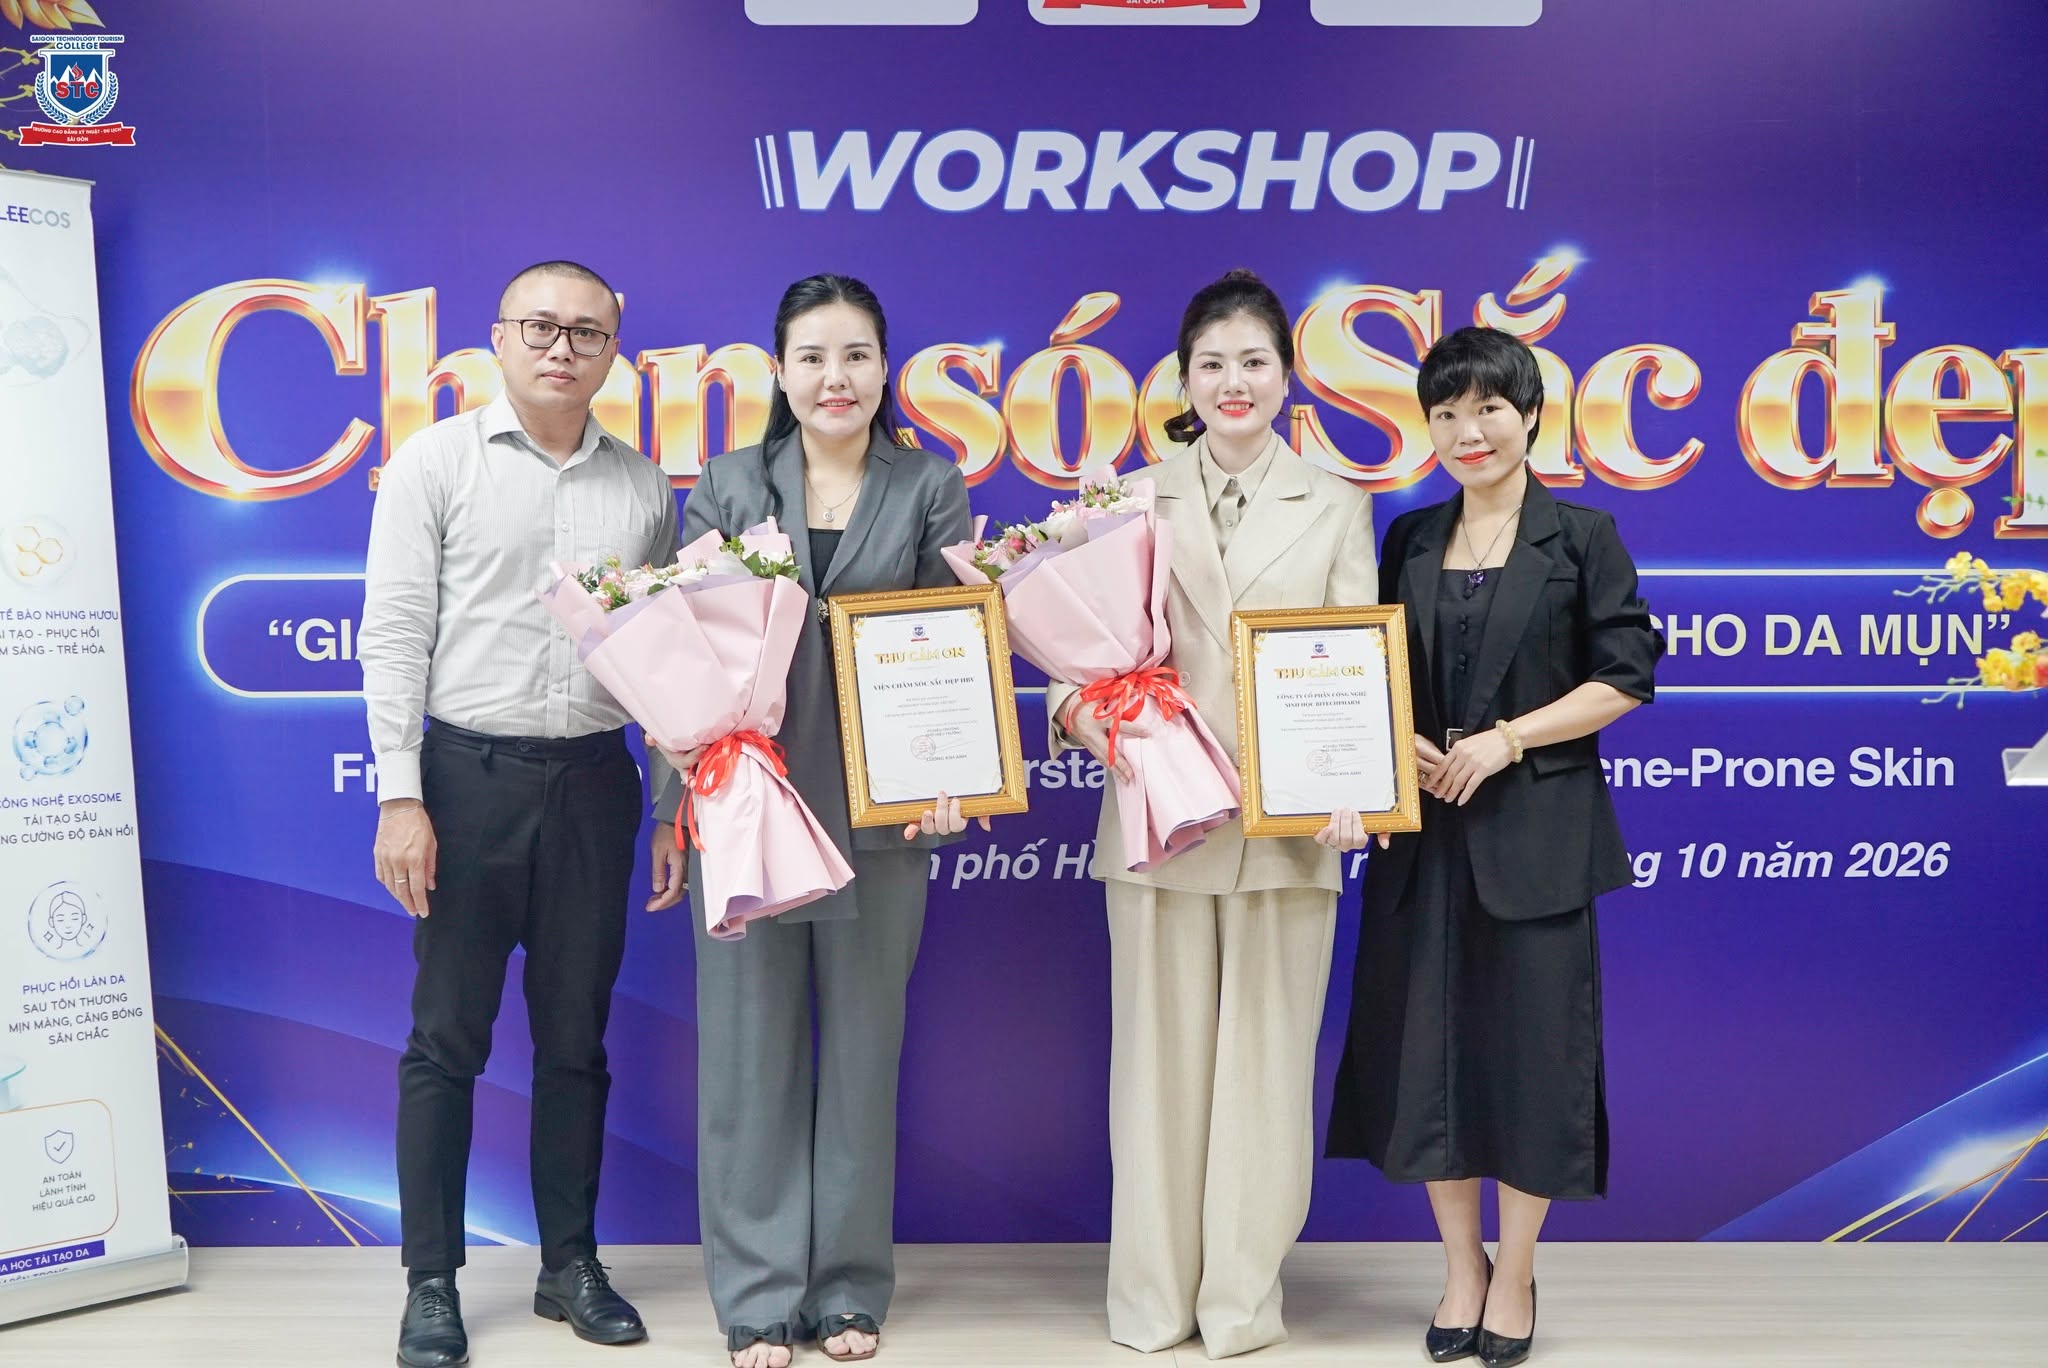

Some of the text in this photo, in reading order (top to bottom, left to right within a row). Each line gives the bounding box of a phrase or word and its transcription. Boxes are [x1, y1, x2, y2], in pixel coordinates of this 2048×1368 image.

[788, 129, 1501, 211] WORKSHOP
[17, 608, 42, 620] BÀO
[45, 610, 86, 620] NHUNG
[89, 610, 118, 620] HƯƠU
[9, 629, 33, 640] TẠO
[46, 628, 78, 640] PHỤC
[1764, 614, 1842, 656] DA
[1860, 614, 2011, 666] MỤN”
[12, 644, 45, 655] SÁNG
[1848, 747, 1955, 787] Skin
[0, 792, 122, 809] ÔNG NGHỆ EXOSOME
[46, 813, 70, 826] TẠO
[74, 811, 97, 823] SÂU
[21, 831, 64, 844] CƯỜNG
[68, 828, 85, 840] ĐỘ
[89, 826, 112, 839] ĐÀN
[951, 838, 1049, 890] phố
[1677, 843, 1726, 878] 10
[1737, 841, 1834, 878] năm
[1844, 842, 1952, 878] 2026
[22, 982, 56, 995] PHỤC
[110, 975, 125, 985] DA
[23, 1002, 47, 1014] SAU
[80, 992, 128, 1007] THƯƠNG
[9, 1021, 31, 1034] MỊN
[43, 1170, 82, 1185] AN TOÀN
[66, 1182, 87, 1193] TÍNH
[76, 1193, 96, 1204] CAO
[10, 1259, 33, 1271] HỌC
[53, 1250, 74, 1263] TẠO
[75, 1248, 90, 1258] DA
